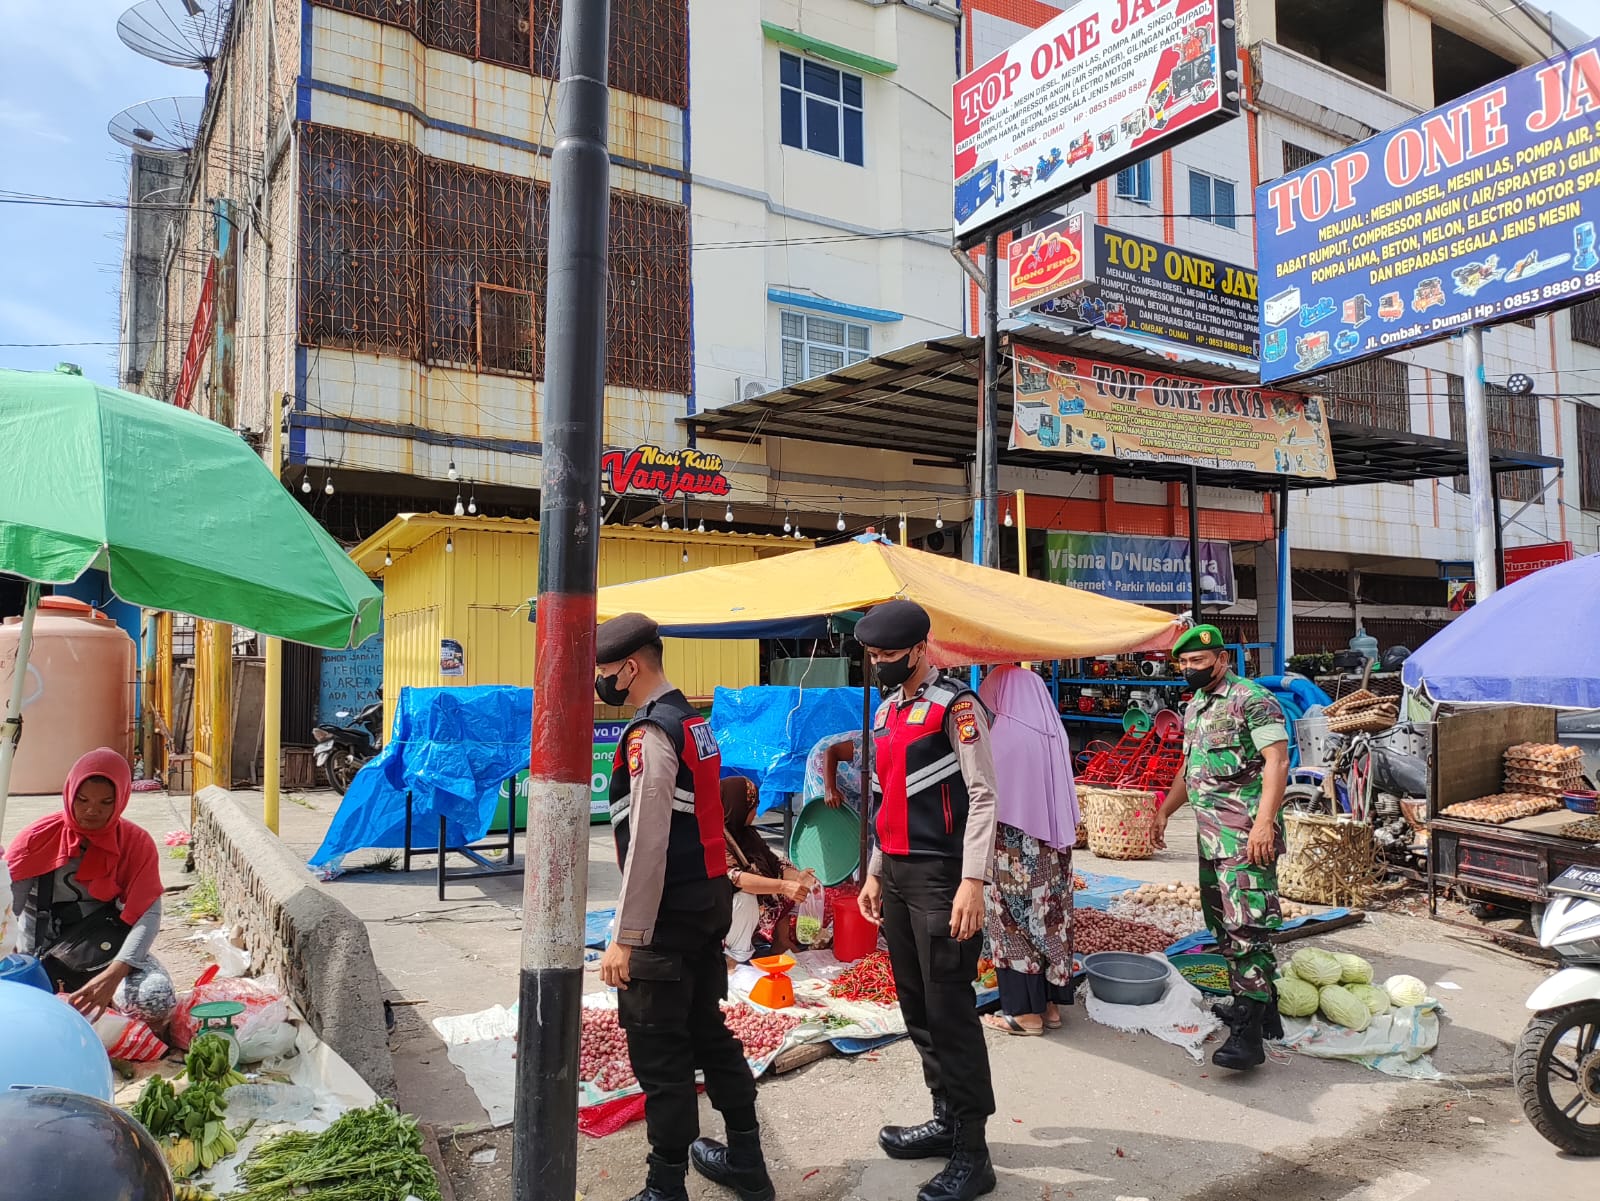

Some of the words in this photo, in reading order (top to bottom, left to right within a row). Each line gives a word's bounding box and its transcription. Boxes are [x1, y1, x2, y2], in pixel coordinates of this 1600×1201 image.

[957, 135, 976, 152] BABAT
[1004, 94, 1048, 126] COMPRESSOR
[1049, 81, 1071, 101] ANGIN
[1072, 72, 1086, 88] (AIR
[1127, 28, 1164, 57] GILINGAN
[1165, 2, 1210, 36] KOPI/PADI,
[962, 61, 1021, 125] TOP
[1030, 12, 1100, 80] ONE
[980, 105, 1010, 128] MENJUAL
[1014, 90, 1035, 109] MESIN
[1036, 76, 1060, 97] DIESEL,
[1061, 62, 1084, 82] MESIN
[1085, 52, 1101, 69] LAS,
[1102, 36, 1130, 59] POMPA
[1130, 26, 1146, 43] AIR,
[1147, 9, 1175, 34] SINSO,
[976, 133, 998, 152] POMPA
[998, 121, 1020, 139] HAMA,
[1020, 108, 1044, 127] BETON,
[1044, 92, 1071, 114] MELON,
[1072, 74, 1103, 99] ELECTRO
[1104, 58, 1132, 81] MOTOR
[1133, 43, 1158, 65] SPARE
[1003, 151, 1012, 162] JL.
[1013, 137, 1037, 157] OMBAK
[1042, 122, 1065, 141] DUMAI
[1073, 113, 1083, 125] HP
[1089, 100, 1106, 116] 0853
[1108, 90, 1127, 106] 8880
[1128, 78, 1147, 96] 8882
[1012, 128, 1026, 142] DAN
[1026, 110, 1059, 135] REPARASI
[1059, 95, 1087, 117] SEGALA
[1088, 83, 1109, 102] JENIS
[1110, 69, 1135, 89] MESIN
[1268, 151, 1370, 236] TOP
[1384, 86, 1509, 188] ONE
[1318, 212, 1364, 242] MENJUAL
[1370, 197, 1402, 222] MESIN
[1404, 181, 1445, 210] DIESEL,
[1447, 166, 1483, 194] MESIN
[1486, 155, 1514, 180] LAS,
[1516, 136, 1563, 168] POMPA
[1566, 125, 1593, 150] AIR,
[1276, 253, 1308, 278] BABAT
[1309, 237, 1351, 266] RUMPUT,
[1352, 211, 1422, 250] COMPRESSOR
[1424, 196, 1460, 223] ANGIN
[1470, 161, 1556, 207] AIR/SPRAYER
[1311, 258, 1346, 284] POMPA
[1347, 246, 1380, 272] HAMA,
[1382, 232, 1421, 260] BETON,
[1423, 216, 1465, 246] MELON,
[1467, 195, 1523, 230] ELECTRO
[1526, 177, 1574, 210] MOTOR
[1370, 263, 1393, 284] DAN
[1394, 244, 1449, 276] REPARASI
[1450, 228, 1498, 258] SEGALA
[1500, 215, 1536, 242] JENIS
[1538, 200, 1580, 230] MESIN
[1016, 267, 1044, 284] DONG
[1046, 255, 1074, 272] FENG
[1104, 233, 1158, 273] TOP
[1164, 250, 1216, 289] ONE
[1106, 267, 1137, 283] MENJUAL
[1142, 276, 1162, 289] MESIN
[1163, 281, 1186, 295] DIESEL,
[1186, 287, 1206, 300] MESIN
[1206, 292, 1219, 304] LAS,
[1220, 296, 1240, 309] POMPA
[1100, 289, 1124, 303] POMPA
[1125, 295, 1147, 308] HAMA,
[1148, 300, 1170, 313] BETON,
[1171, 306, 1194, 319] MELON,
[1195, 312, 1220, 325] ELECTRO
[1222, 318, 1242, 330] MOTOR
[1101, 278, 1130, 293] RUMPUT,
[1131, 285, 1175, 304] COMPRESSOR
[1176, 296, 1194, 309] ANGIN
[1380, 324, 1422, 345] Ombak
[1432, 309, 1472, 331] Dumai
[1475, 304, 1494, 318] Hp
[1504, 288, 1540, 309] 0853
[1542, 277, 1581, 298] 8880
[1129, 320, 1139, 329] JL.
[1140, 322, 1164, 335] OMBAK
[1168, 328, 1189, 340] DUMAI
[1195, 334, 1205, 344] HP
[1208, 338, 1223, 348] 0853
[1139, 310, 1152, 321] DAN
[1154, 313, 1183, 328] REPARASI
[1184, 320, 1207, 333] SEGALA
[1208, 325, 1225, 337] JENIS
[1226, 329, 1244, 341] MESIN
[1092, 364, 1146, 402] TOP
[1151, 376, 1204, 412] ONE
[1208, 386, 1268, 420] JAYA
[638, 446, 681, 466] Nasi
[681, 450, 723, 471] Kulit
[1048, 549, 1106, 569] Visma
[1115, 581, 1144, 593] Parkir
[1146, 582, 1174, 593] Mobil
[1176, 581, 1186, 592] di
[328, 692, 347, 700] ADA
[337, 676, 372, 688] AREA
